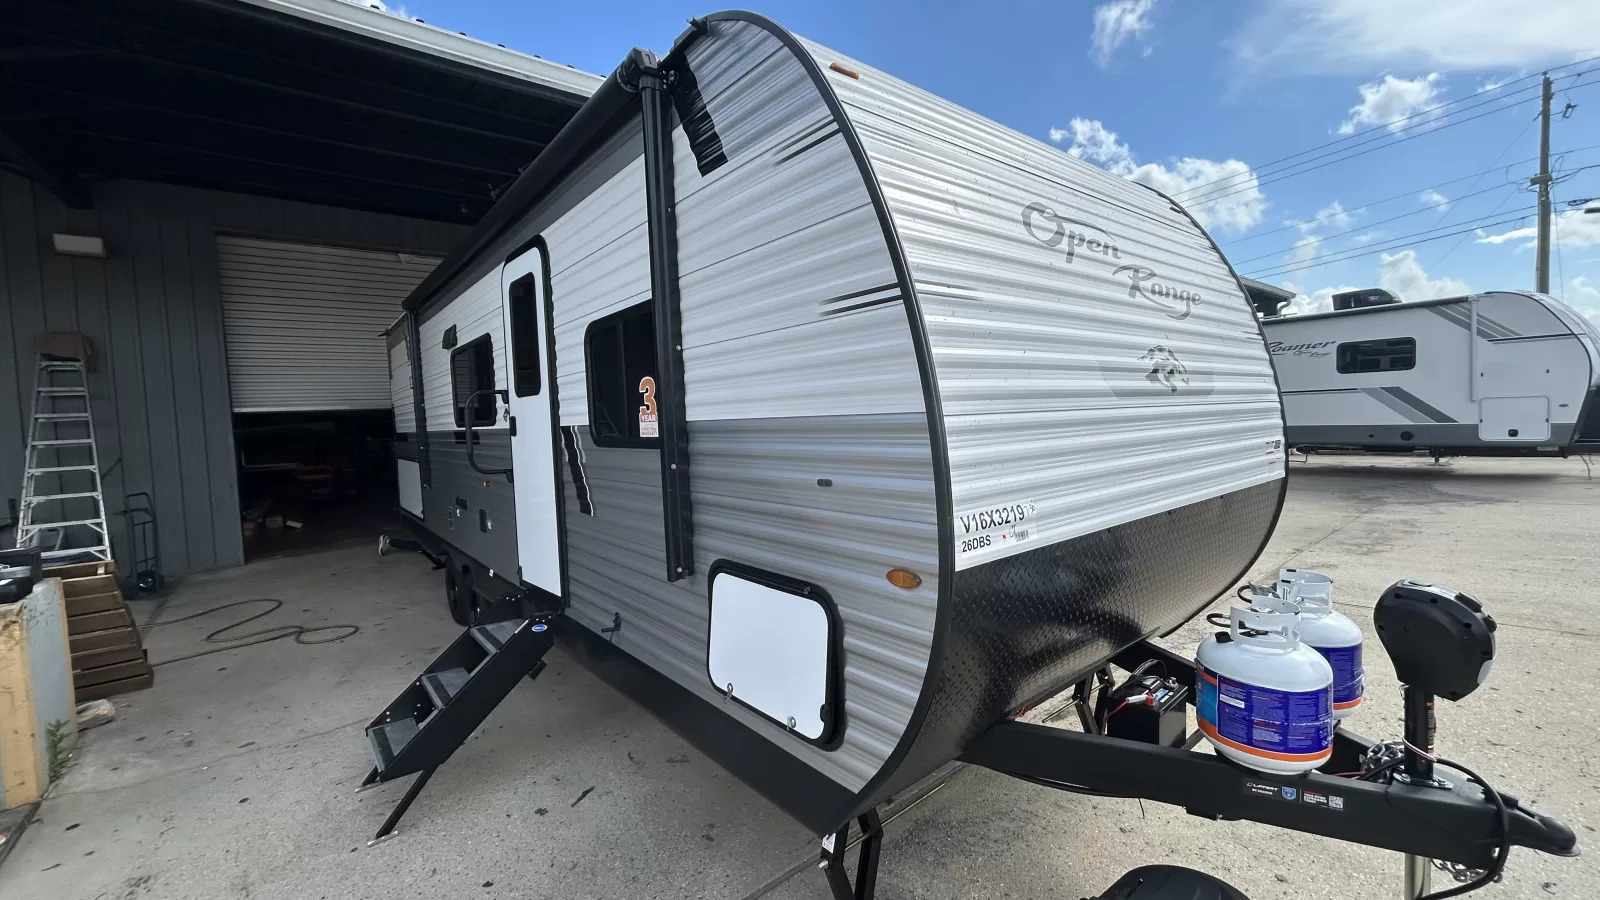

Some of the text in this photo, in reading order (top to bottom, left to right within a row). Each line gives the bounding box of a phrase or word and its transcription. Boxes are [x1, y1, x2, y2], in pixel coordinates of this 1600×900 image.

[1021, 202, 1122, 263] Open
[1112, 264, 1202, 320] Range
[639, 377, 656, 414] 3
[640, 414, 657, 422] YEAR
[960, 504, 1025, 534] V16X3219
[961, 534, 992, 553] 26DBS
